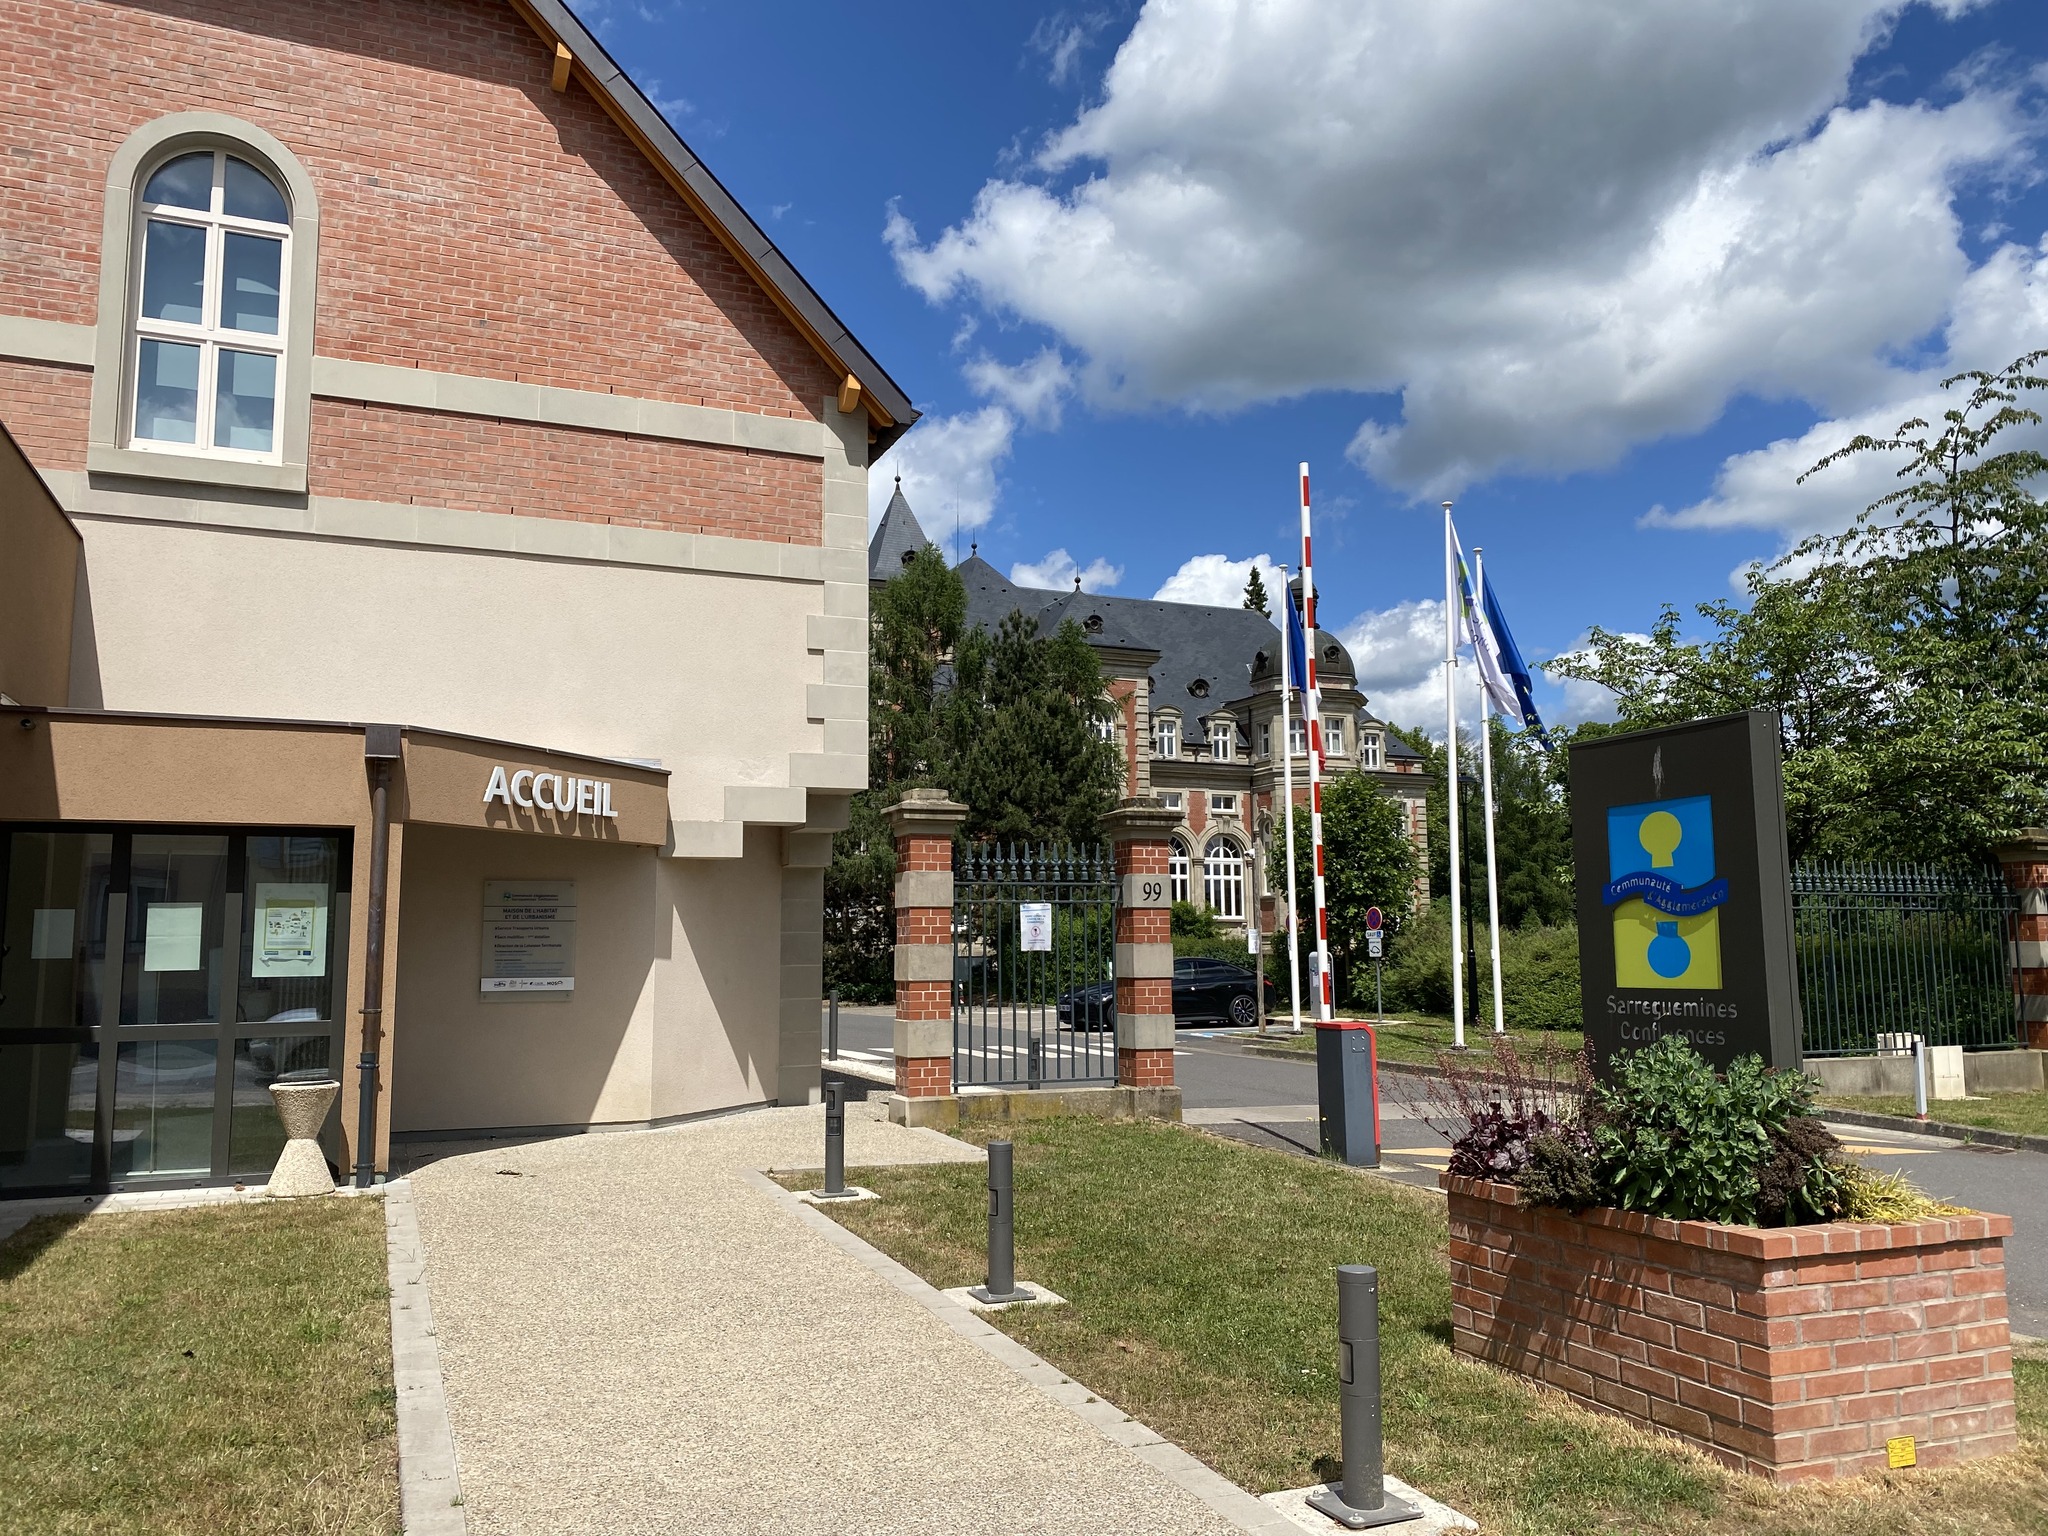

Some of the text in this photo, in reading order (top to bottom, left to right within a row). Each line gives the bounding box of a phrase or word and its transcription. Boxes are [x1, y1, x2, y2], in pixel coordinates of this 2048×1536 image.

[483, 766, 618, 817] ACCUEIL
[1143, 882, 1161, 901] 99
[1610, 877, 1672, 896] Communauté
[1606, 995, 1738, 1020] Sarreguemines
[1620, 1021, 1726, 1046] Conflences
